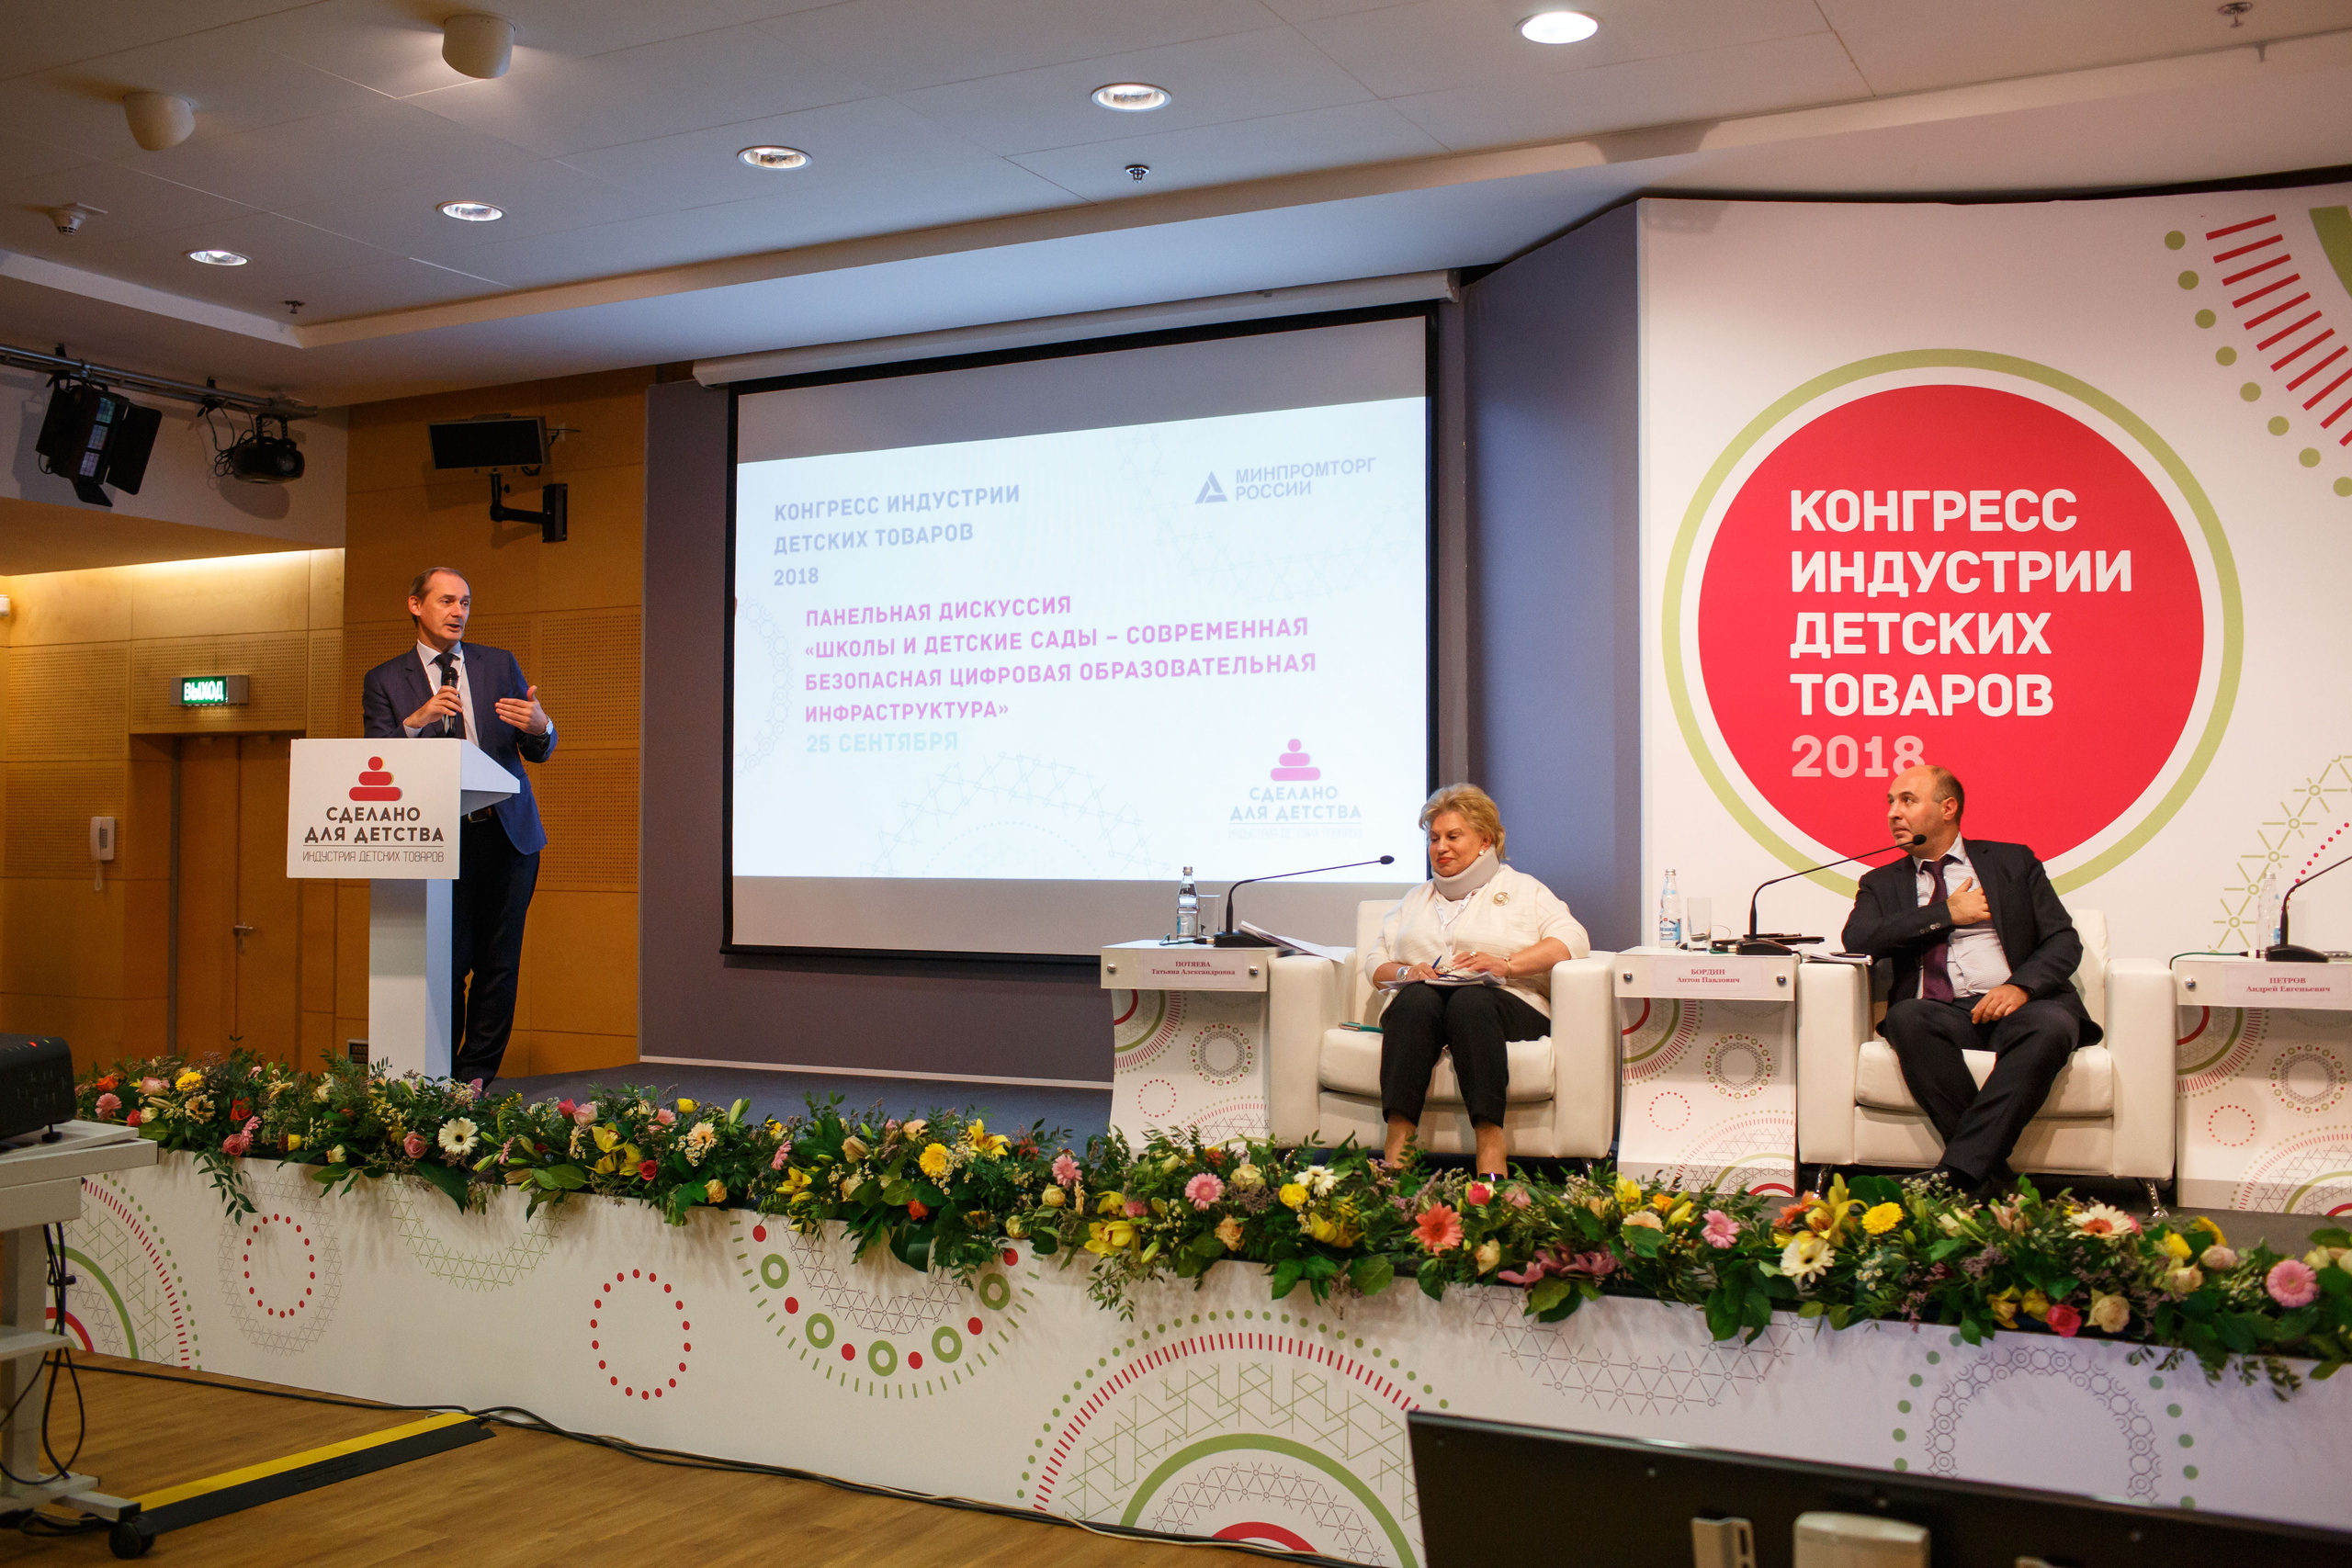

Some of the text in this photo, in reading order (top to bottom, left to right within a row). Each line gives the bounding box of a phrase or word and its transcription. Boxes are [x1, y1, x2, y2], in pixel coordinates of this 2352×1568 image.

[1236, 457, 1376, 484] МИНПРОМТОРГ
[775, 484, 1020, 522] КОНГРЕСС ИНДУСТРИИ
[1236, 480, 1311, 501] РОССИИ
[1791, 489, 2077, 532] КОНГРЕСС
[774, 523, 973, 556] ДЕТСКИХ ТОВАРОВ
[774, 567, 819, 586] 2018
[1791, 549, 2132, 598] ИНДУСТРИИ
[806, 595, 1070, 626] ПАНЕЛЬНАЯ ДИСКУССИЯ
[805, 638, 895, 659] «ШКОЛЫ
[904, 637, 916, 654] И
[923, 632, 1022, 655] ДЕТСКИЕ
[1030, 628, 1097, 649] САДЫ
[1126, 617, 1307, 644] СОВРЕМЕННАЯ
[1790, 612, 2052, 659] ДЕТСКИХ
[805, 653, 1316, 691] БЕЗОПАСНАЯ ЦИФРОВАЯ ОБРАЗОВАТЕЛЬНАЯ
[184, 681, 223, 702] ВЫХОД
[1790, 672, 2053, 716] ТОВАРОВ
[805, 700, 1009, 723] ИНФРАСТРУКТУРА»
[806, 731, 957, 752] 25 СЕНТЯБРЯ
[1791, 734, 1926, 778] 2018
[1249, 785, 1339, 803] СДЕЛАНО
[325, 807, 421, 824] СДЕЛАНО
[1229, 805, 1362, 821] ДЛЯ ДЕТСТВА
[304, 827, 445, 844] ДЛЯ ДЕТСТВА
[302, 850, 445, 863] ИНДУСТРИЯ ДЕТСКИХ ТОВАРОВ
